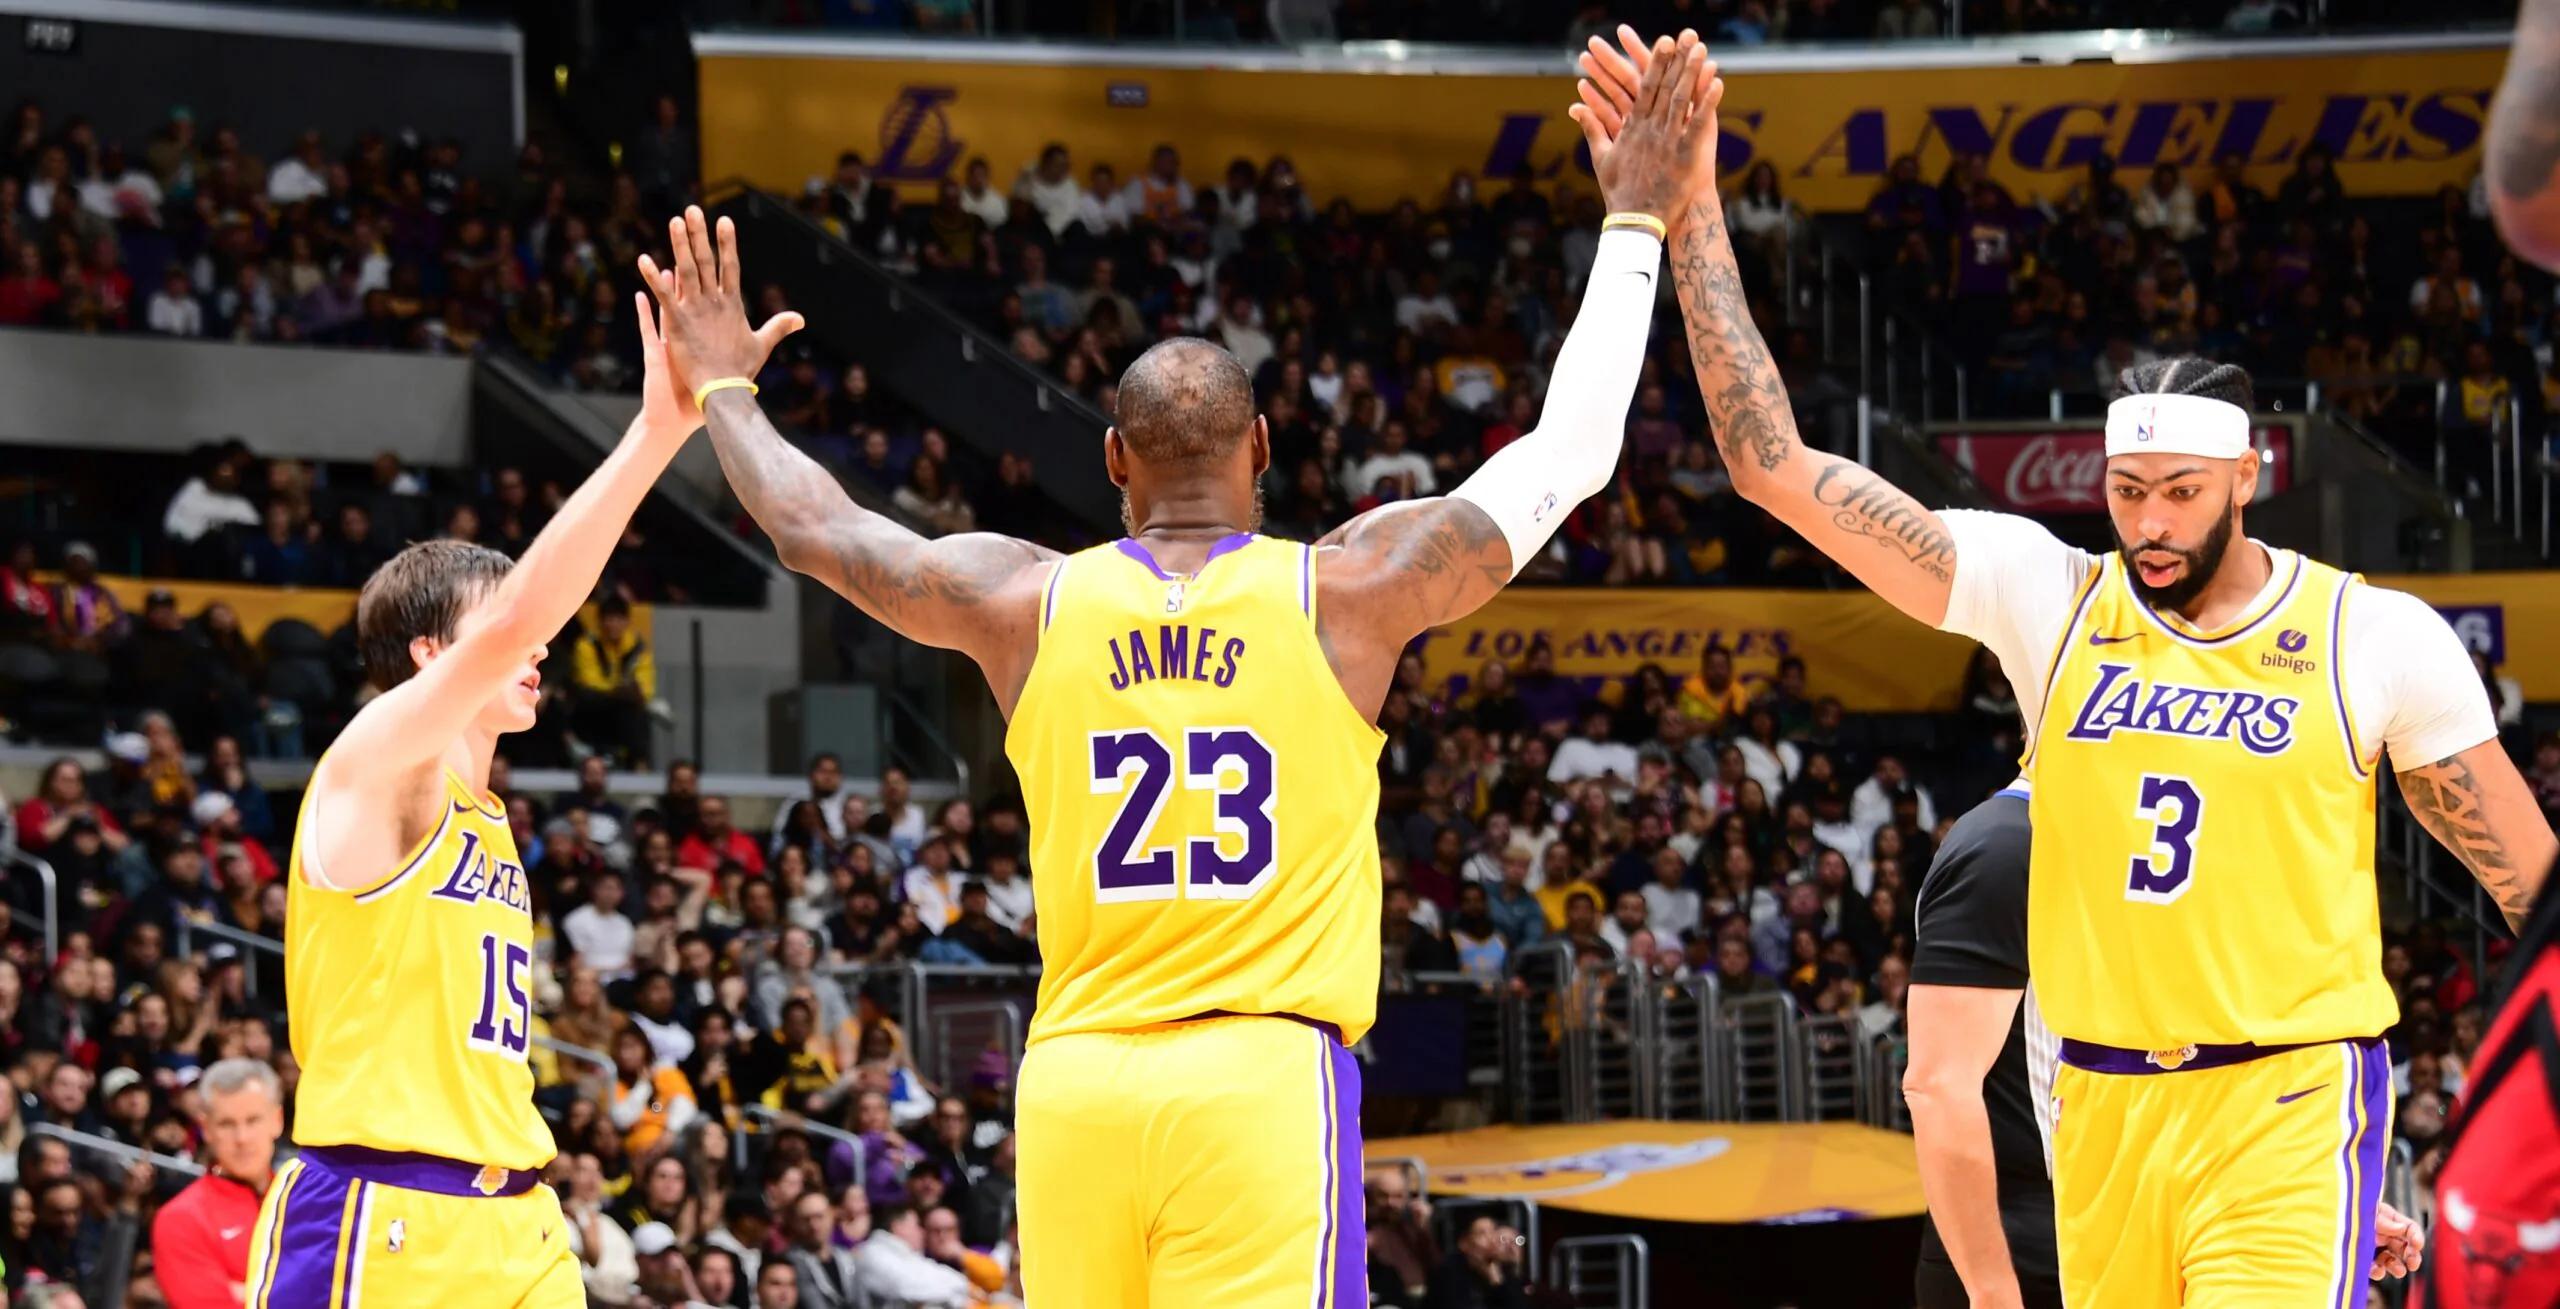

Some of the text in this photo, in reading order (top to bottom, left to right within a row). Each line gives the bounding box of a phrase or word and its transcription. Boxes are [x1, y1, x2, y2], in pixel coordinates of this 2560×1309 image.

[1482, 85, 2492, 178] LS ANGELES
[1814, 463, 1957, 564] Chicago
[1108, 625, 1245, 690] JAMES
[1562, 626, 1794, 658] ANGELES
[2260, 652, 2316, 675] bibigo
[2066, 663, 2300, 755] LAKERS
[1090, 728, 1276, 900] 23
[2127, 774, 2203, 900] 3
[470, 933, 530, 1056] 15
